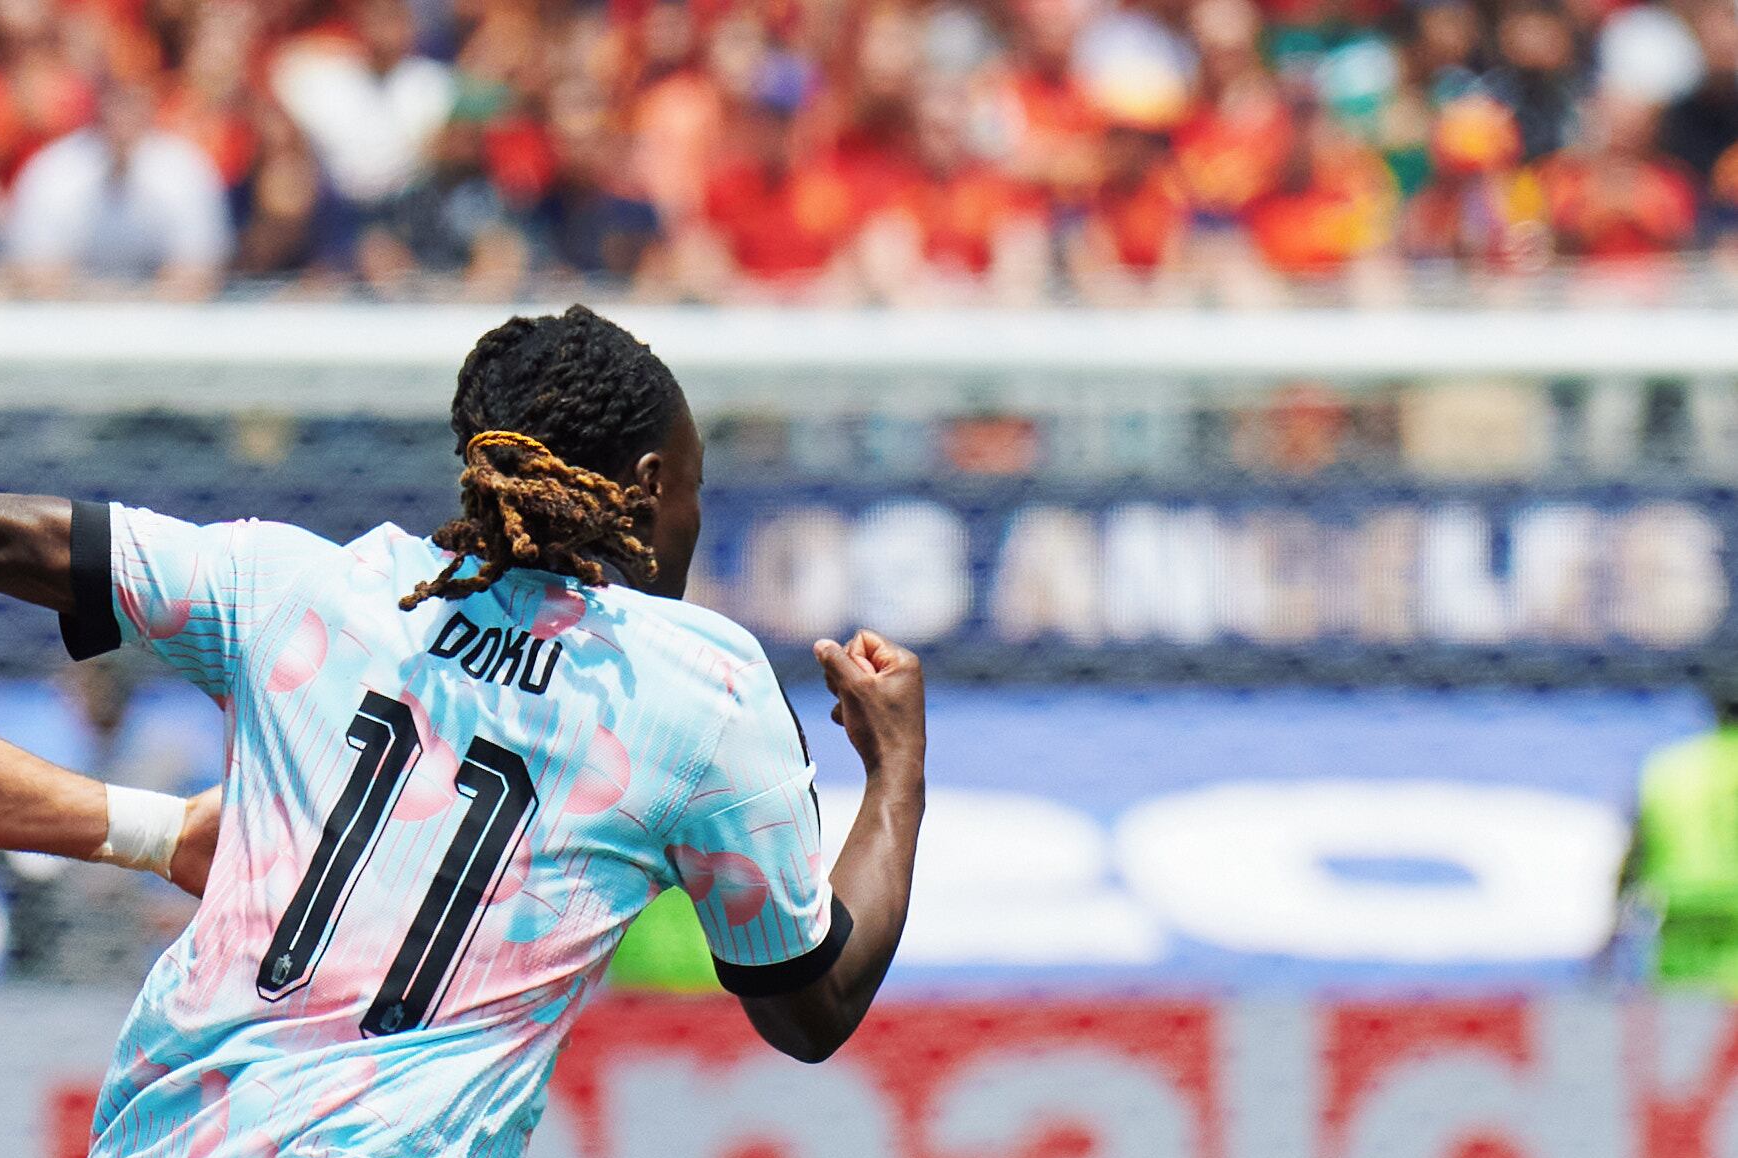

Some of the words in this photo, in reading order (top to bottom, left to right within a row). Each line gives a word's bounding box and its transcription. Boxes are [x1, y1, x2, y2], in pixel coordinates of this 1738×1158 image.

[687, 500, 970, 641] OS
[428, 611, 563, 695] DOKU
[256, 690, 539, 1039] 11
